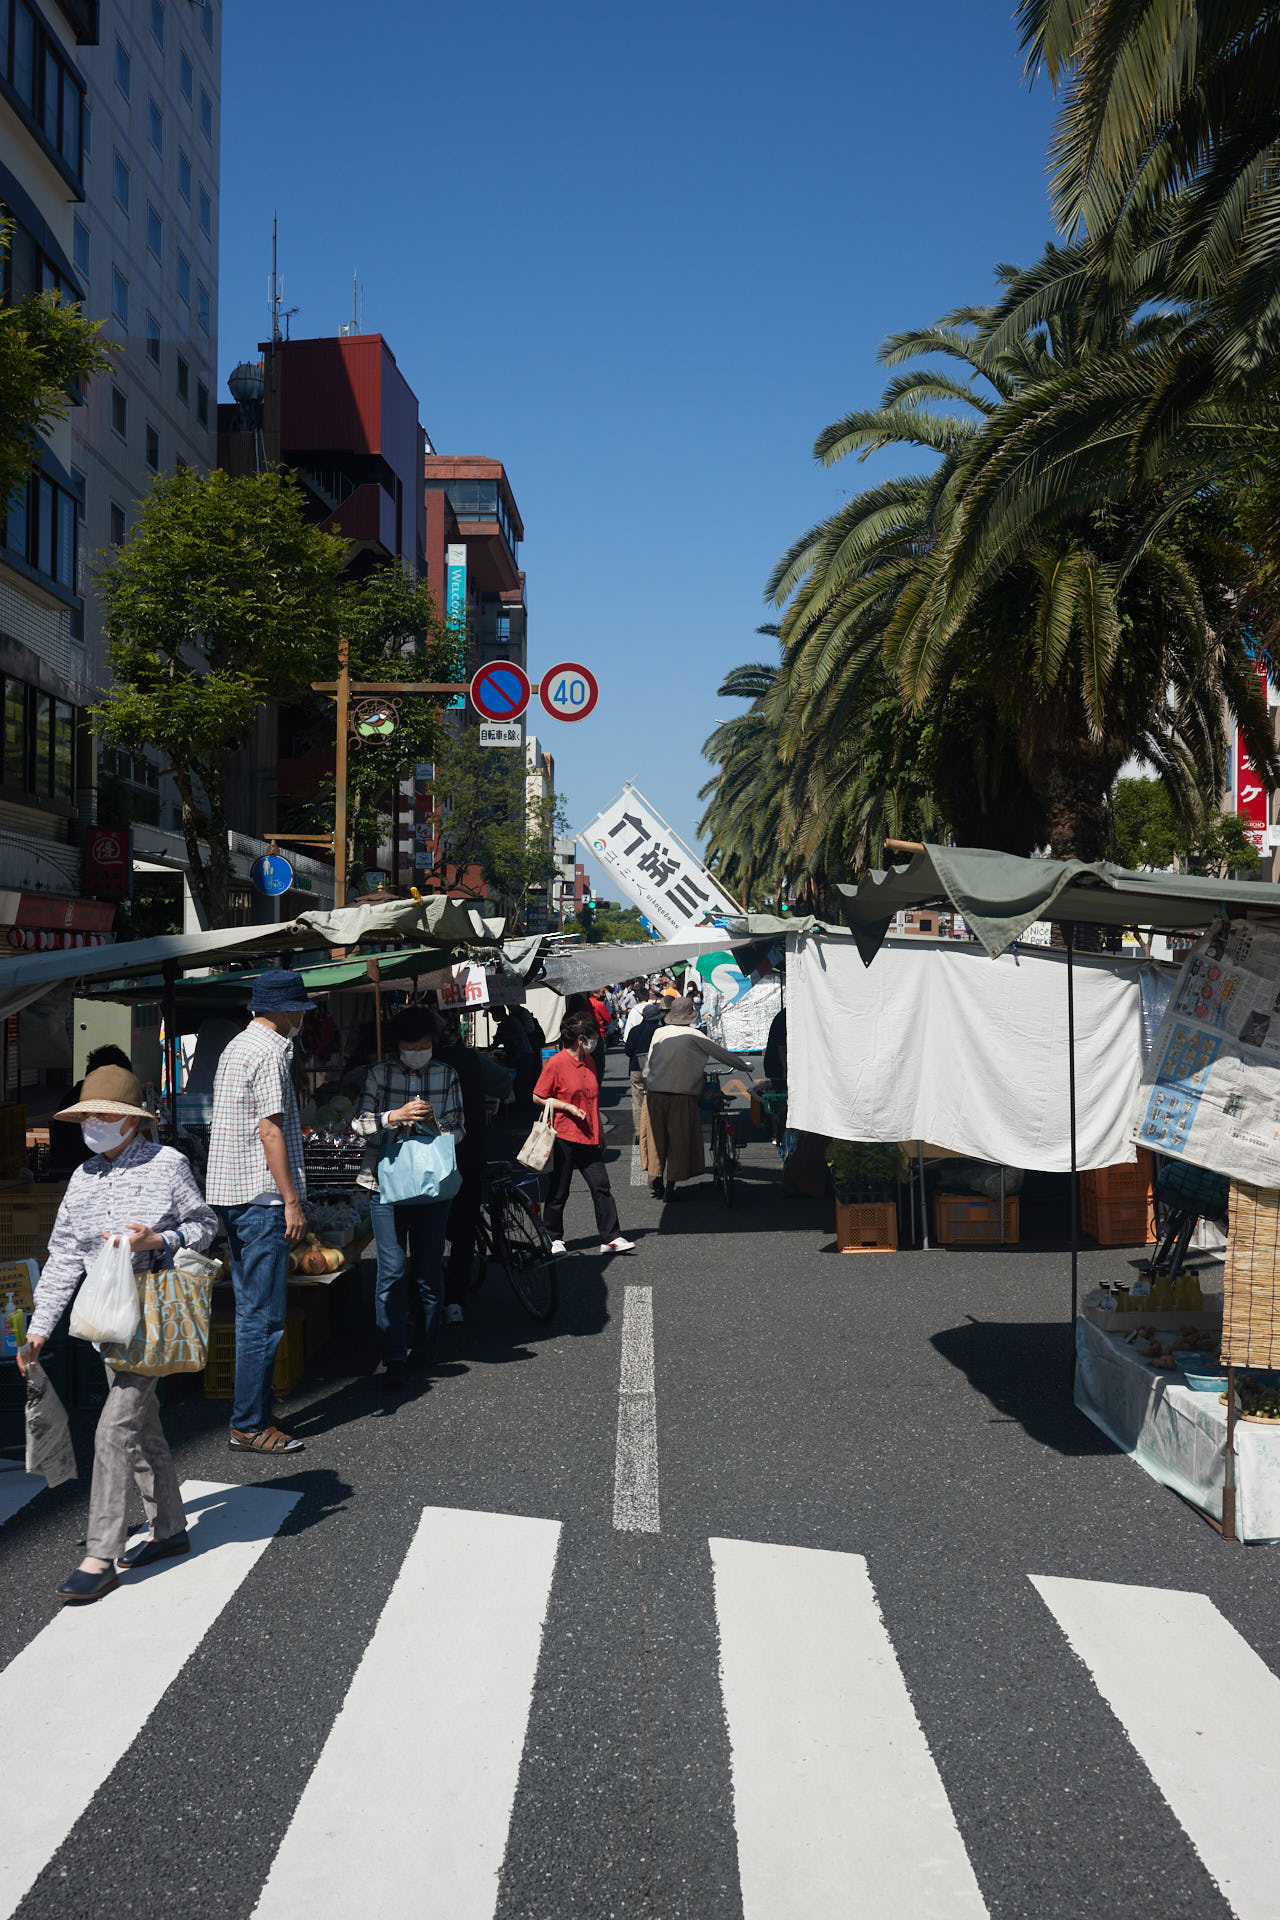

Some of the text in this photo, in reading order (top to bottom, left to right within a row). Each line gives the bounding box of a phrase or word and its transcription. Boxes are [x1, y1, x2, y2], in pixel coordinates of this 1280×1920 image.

[553, 679, 585, 705] 40
[481, 729, 520, 741] 自転車を除く
[1030, 926, 1050, 936] Nice
